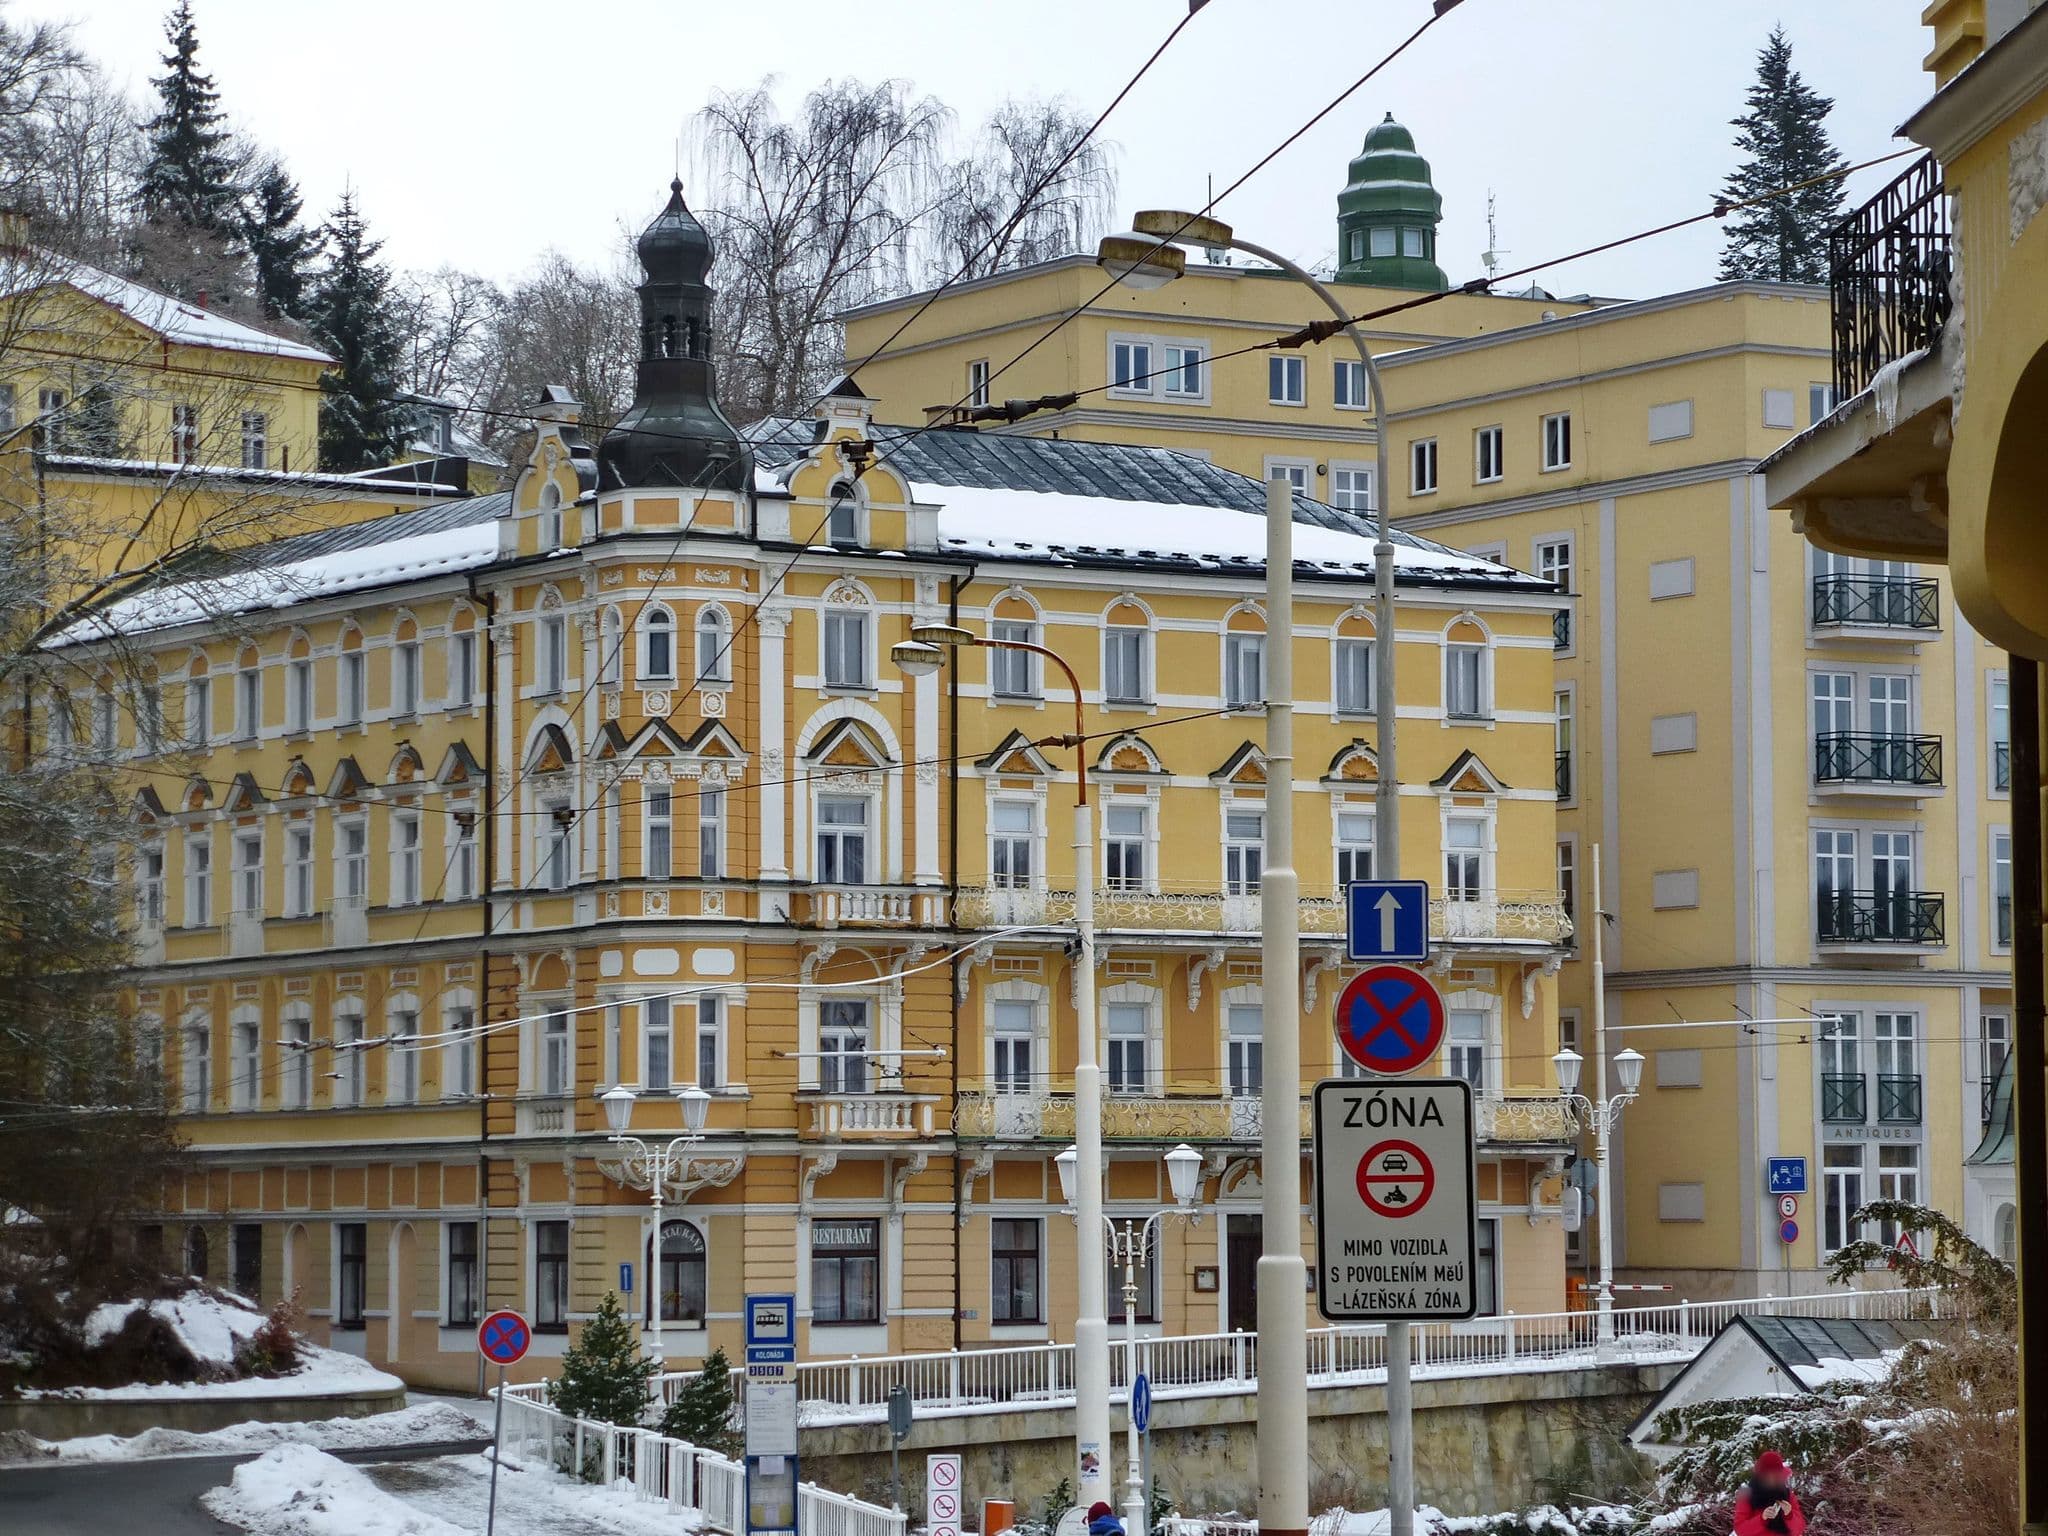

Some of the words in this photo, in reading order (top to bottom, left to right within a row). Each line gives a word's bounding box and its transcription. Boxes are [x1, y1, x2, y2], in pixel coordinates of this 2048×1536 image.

[1343, 1089, 1444, 1128] ZÓNA
[1834, 1128, 1912, 1138] ANTIQUES
[1785, 1200, 1792, 1212] 5
[812, 1227, 872, 1245] RESTAURANT
[1344, 1239, 1382, 1256] MIMO
[1390, 1238, 1448, 1256] VOZIDLA
[1331, 1266, 1340, 1283] S
[1347, 1261, 1427, 1283] POVOLENÍM
[1434, 1261, 1463, 1282] MěÚ
[1334, 1288, 1417, 1310] -LÁZEŇSKÁ
[1424, 1288, 1462, 1309] ZÓNA
